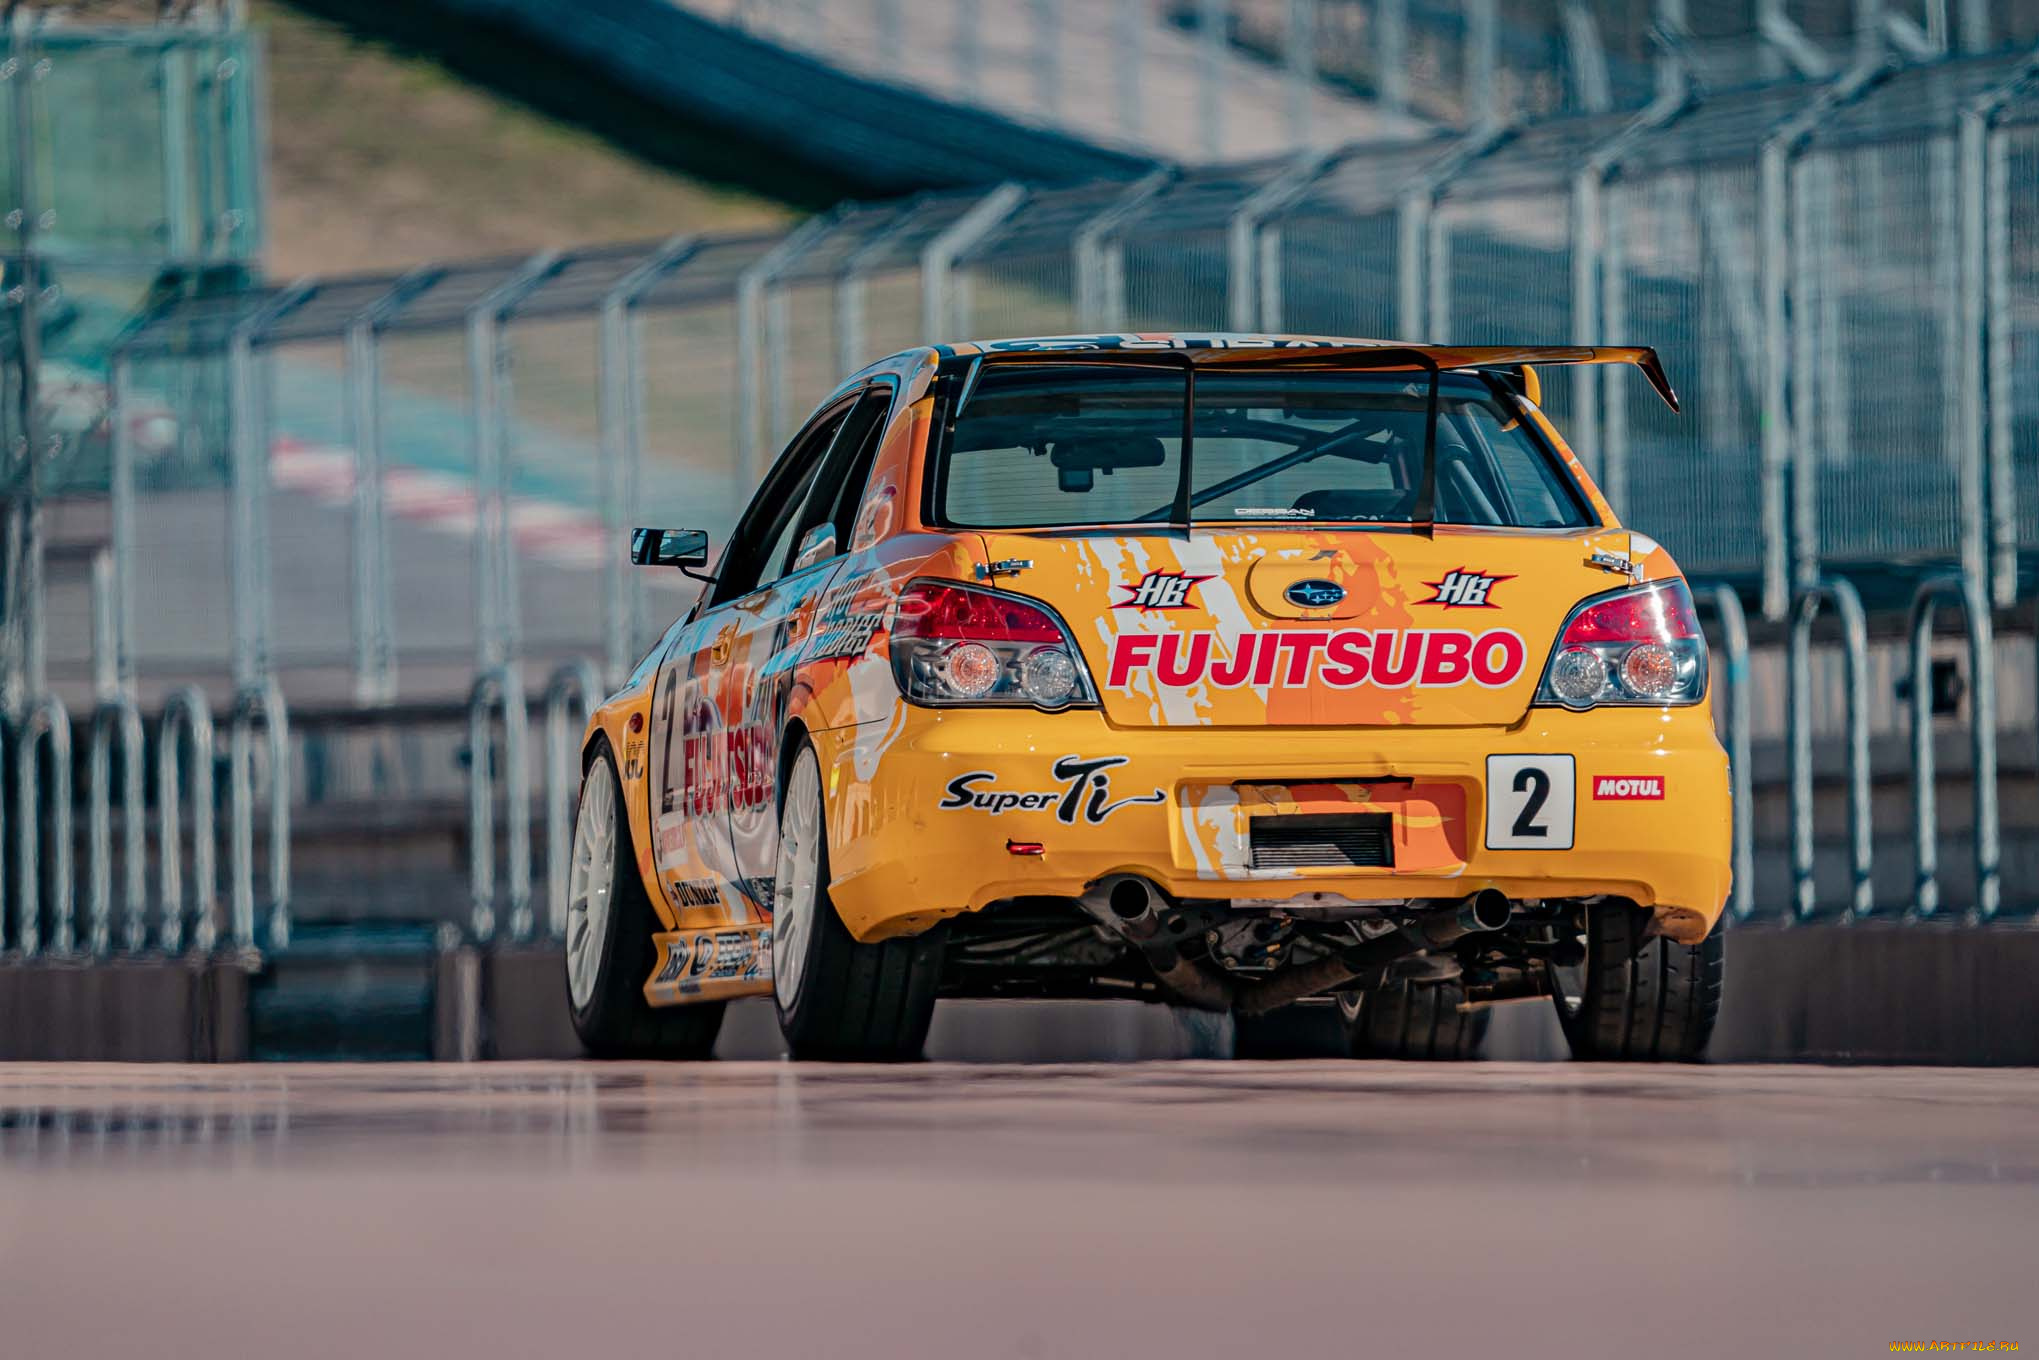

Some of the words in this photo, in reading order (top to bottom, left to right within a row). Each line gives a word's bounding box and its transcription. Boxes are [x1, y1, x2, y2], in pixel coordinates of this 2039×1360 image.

[1106, 629, 1526, 689] FUJITSUBO
[939, 771, 1060, 816] Super
[1052, 754, 1167, 826] Ti
[1511, 767, 1551, 837] 2
[1597, 779, 1661, 796] MOTUL
[675, 878, 721, 907] DUNLOP
